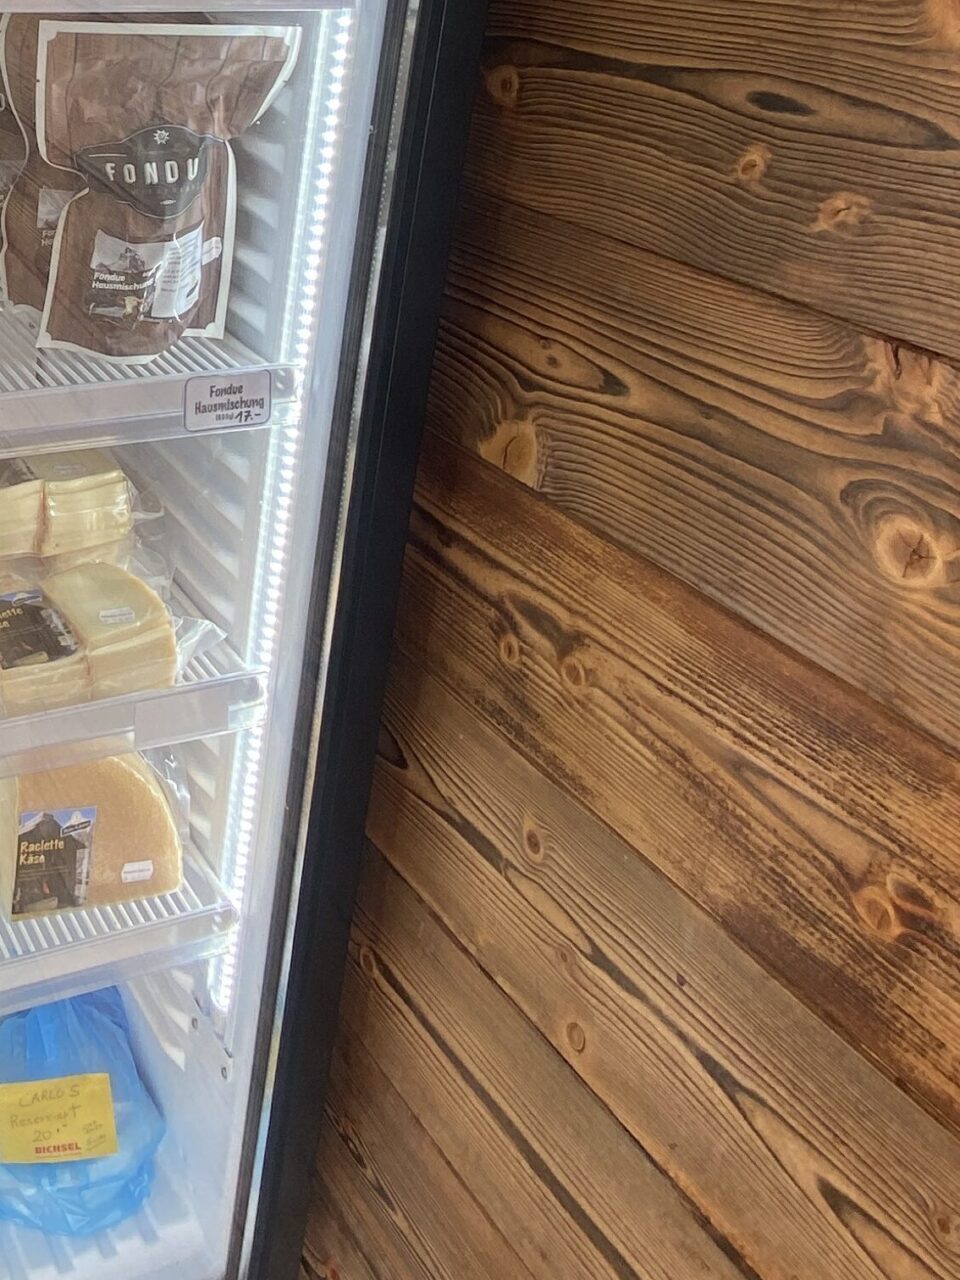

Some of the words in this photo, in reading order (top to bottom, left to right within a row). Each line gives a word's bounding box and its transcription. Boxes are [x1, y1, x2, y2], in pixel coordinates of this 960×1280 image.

[105, 156, 200, 188] FONDU
[93, 271, 126, 282] Fondue
[209, 383, 244, 398] Fondue
[194, 397, 265, 416] Hausmischung
[19, 839, 65, 854] Raclette
[19, 852, 46, 866] Käse
[34, 1141, 82, 1155] BICHSEL
